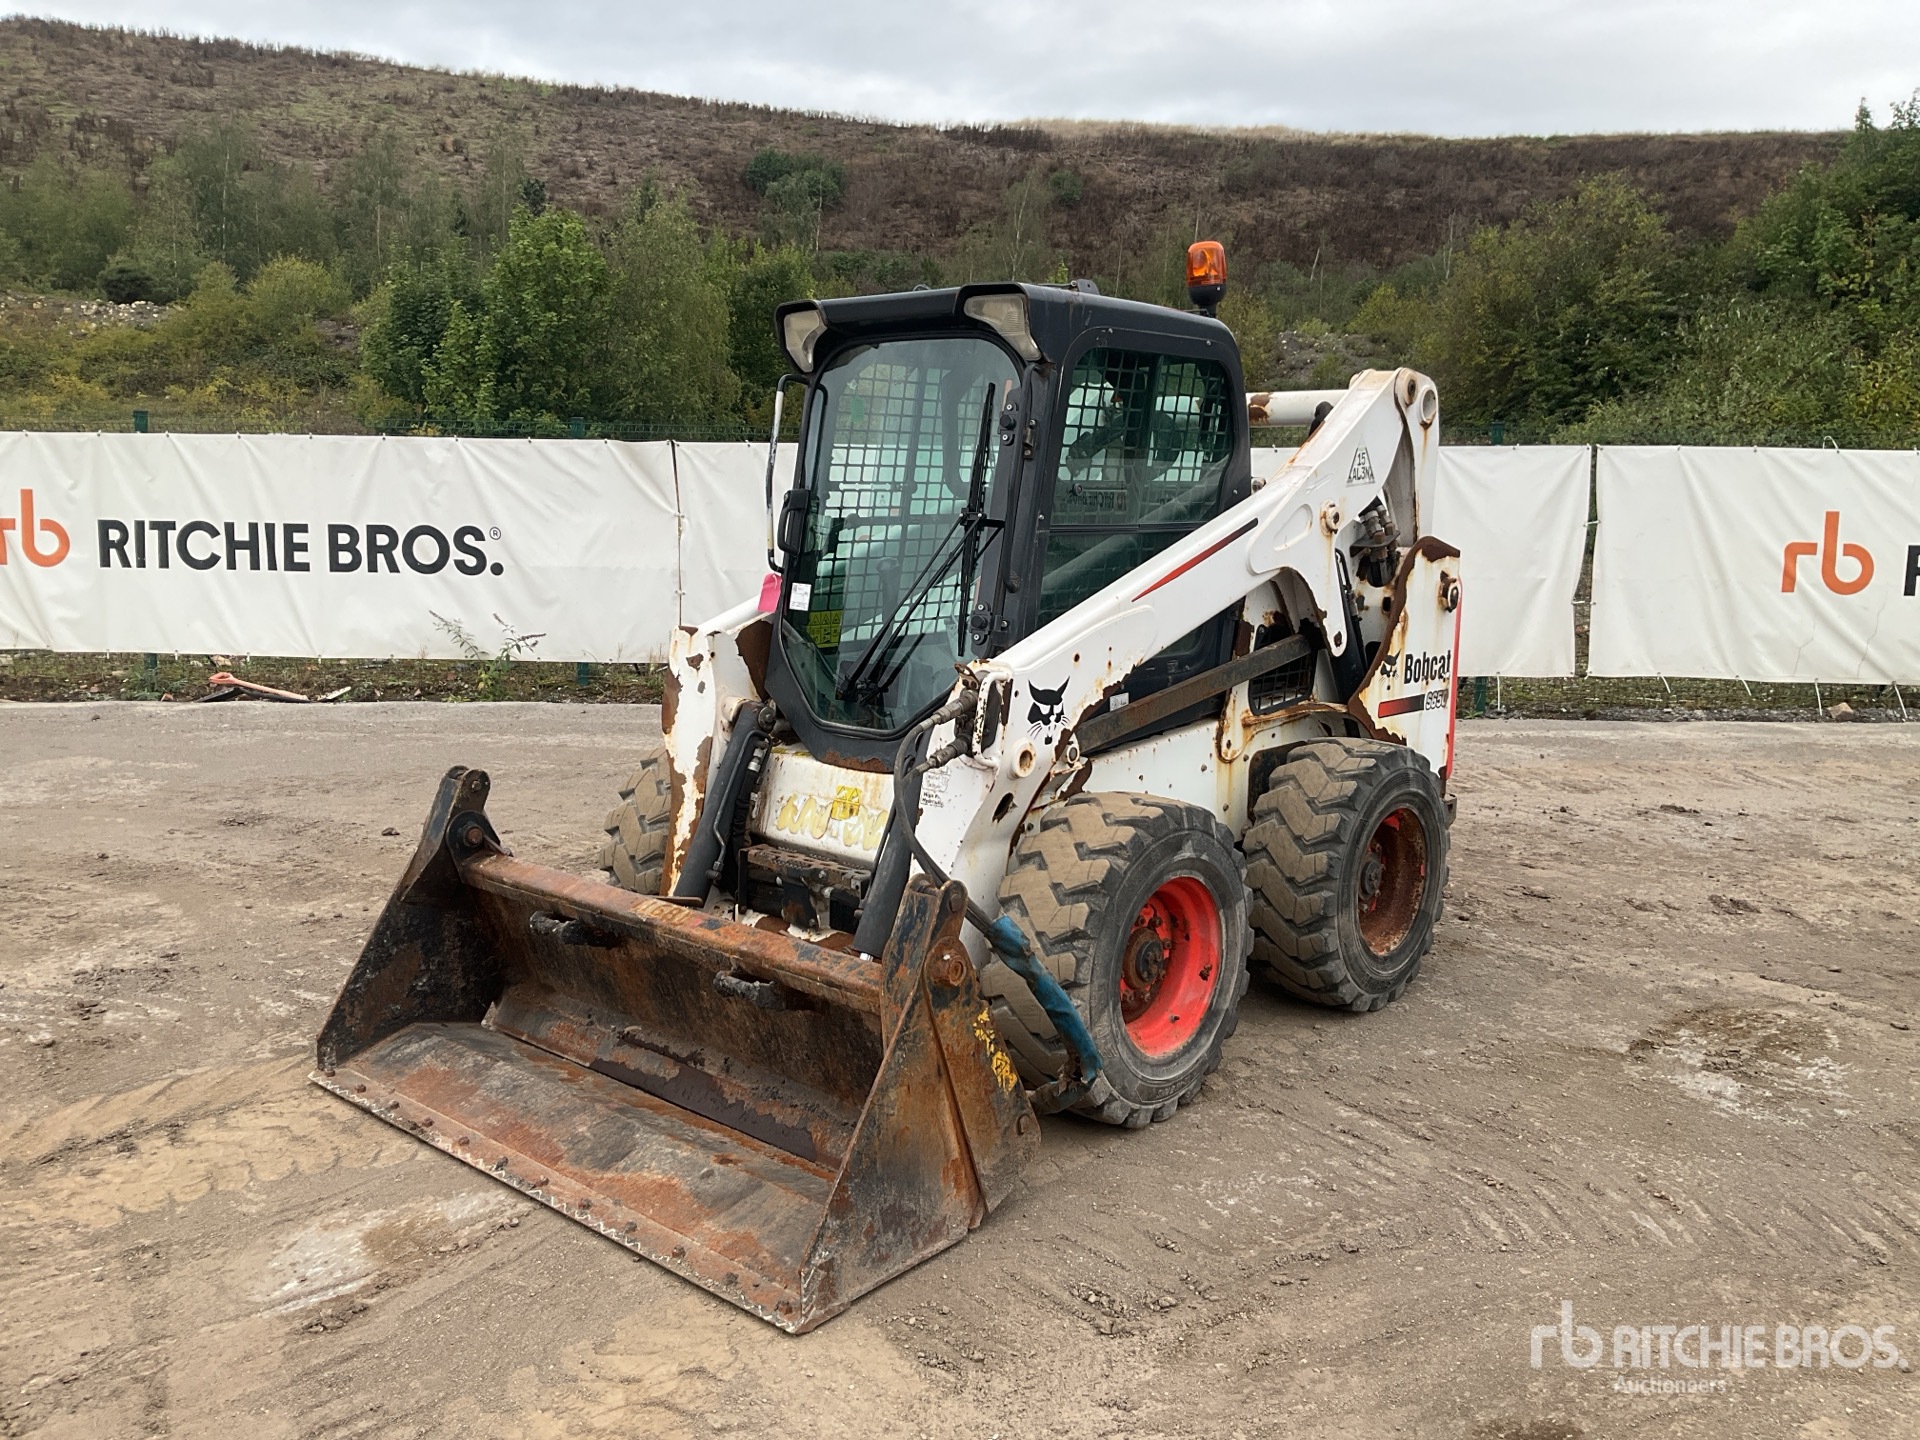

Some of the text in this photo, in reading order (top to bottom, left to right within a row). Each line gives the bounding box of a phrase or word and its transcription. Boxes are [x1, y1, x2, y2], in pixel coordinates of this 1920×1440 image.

[1357, 452, 1366, 466] 15
[98, 519, 311, 572] RITCHIE
[1781, 511, 1875, 596] rb
[1404, 650, 1451, 684] Bobcat
